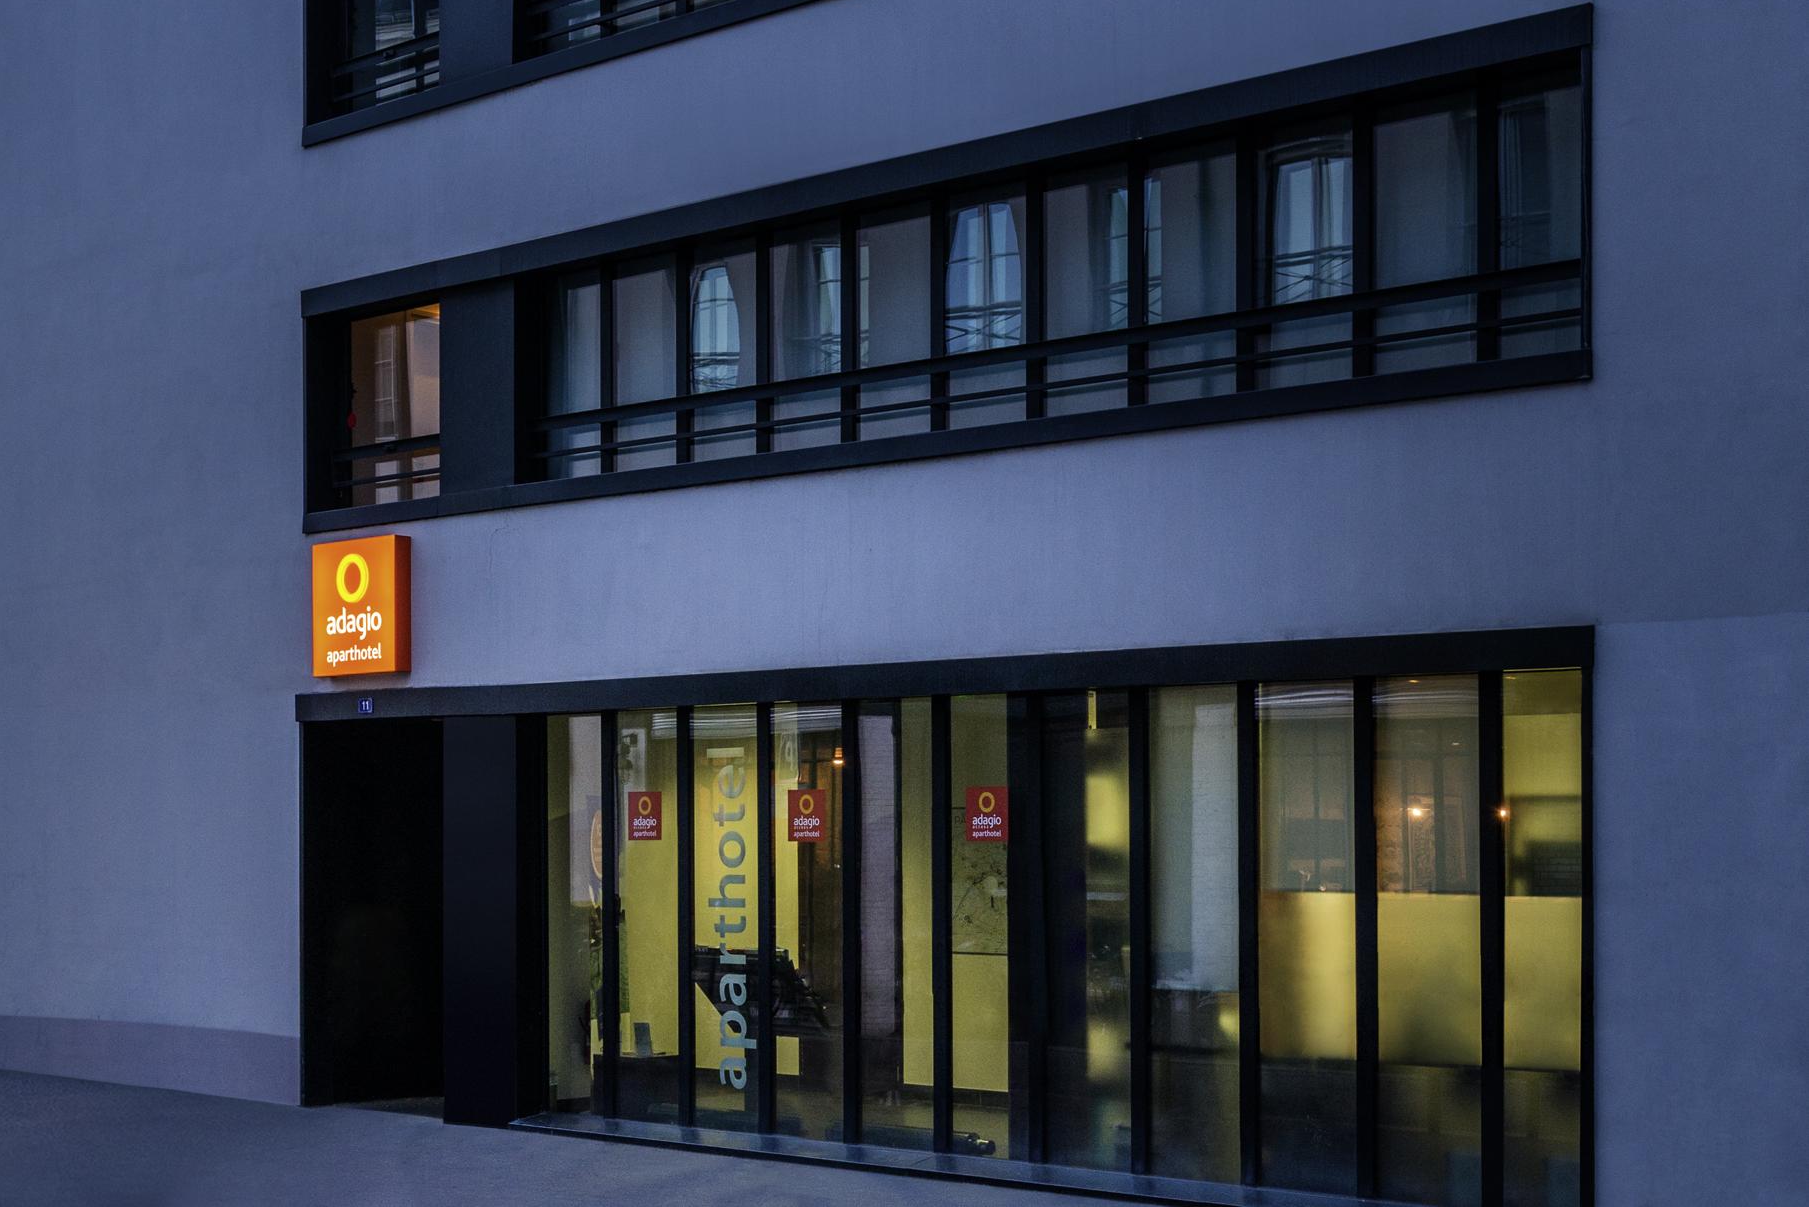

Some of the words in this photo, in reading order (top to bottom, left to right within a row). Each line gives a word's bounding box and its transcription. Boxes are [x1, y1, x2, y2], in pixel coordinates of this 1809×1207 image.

[326, 605, 382, 640] adagio
[326, 642, 382, 667] aparthotel
[633, 816, 657, 829] adagio
[793, 816, 820, 829] adagio
[972, 813, 1002, 829] adagio
[633, 830, 657, 838] aparthotel
[793, 830, 820, 839] aparthotel
[972, 830, 1002, 839] aparthotel
[706, 747, 757, 1090] aparthotel
